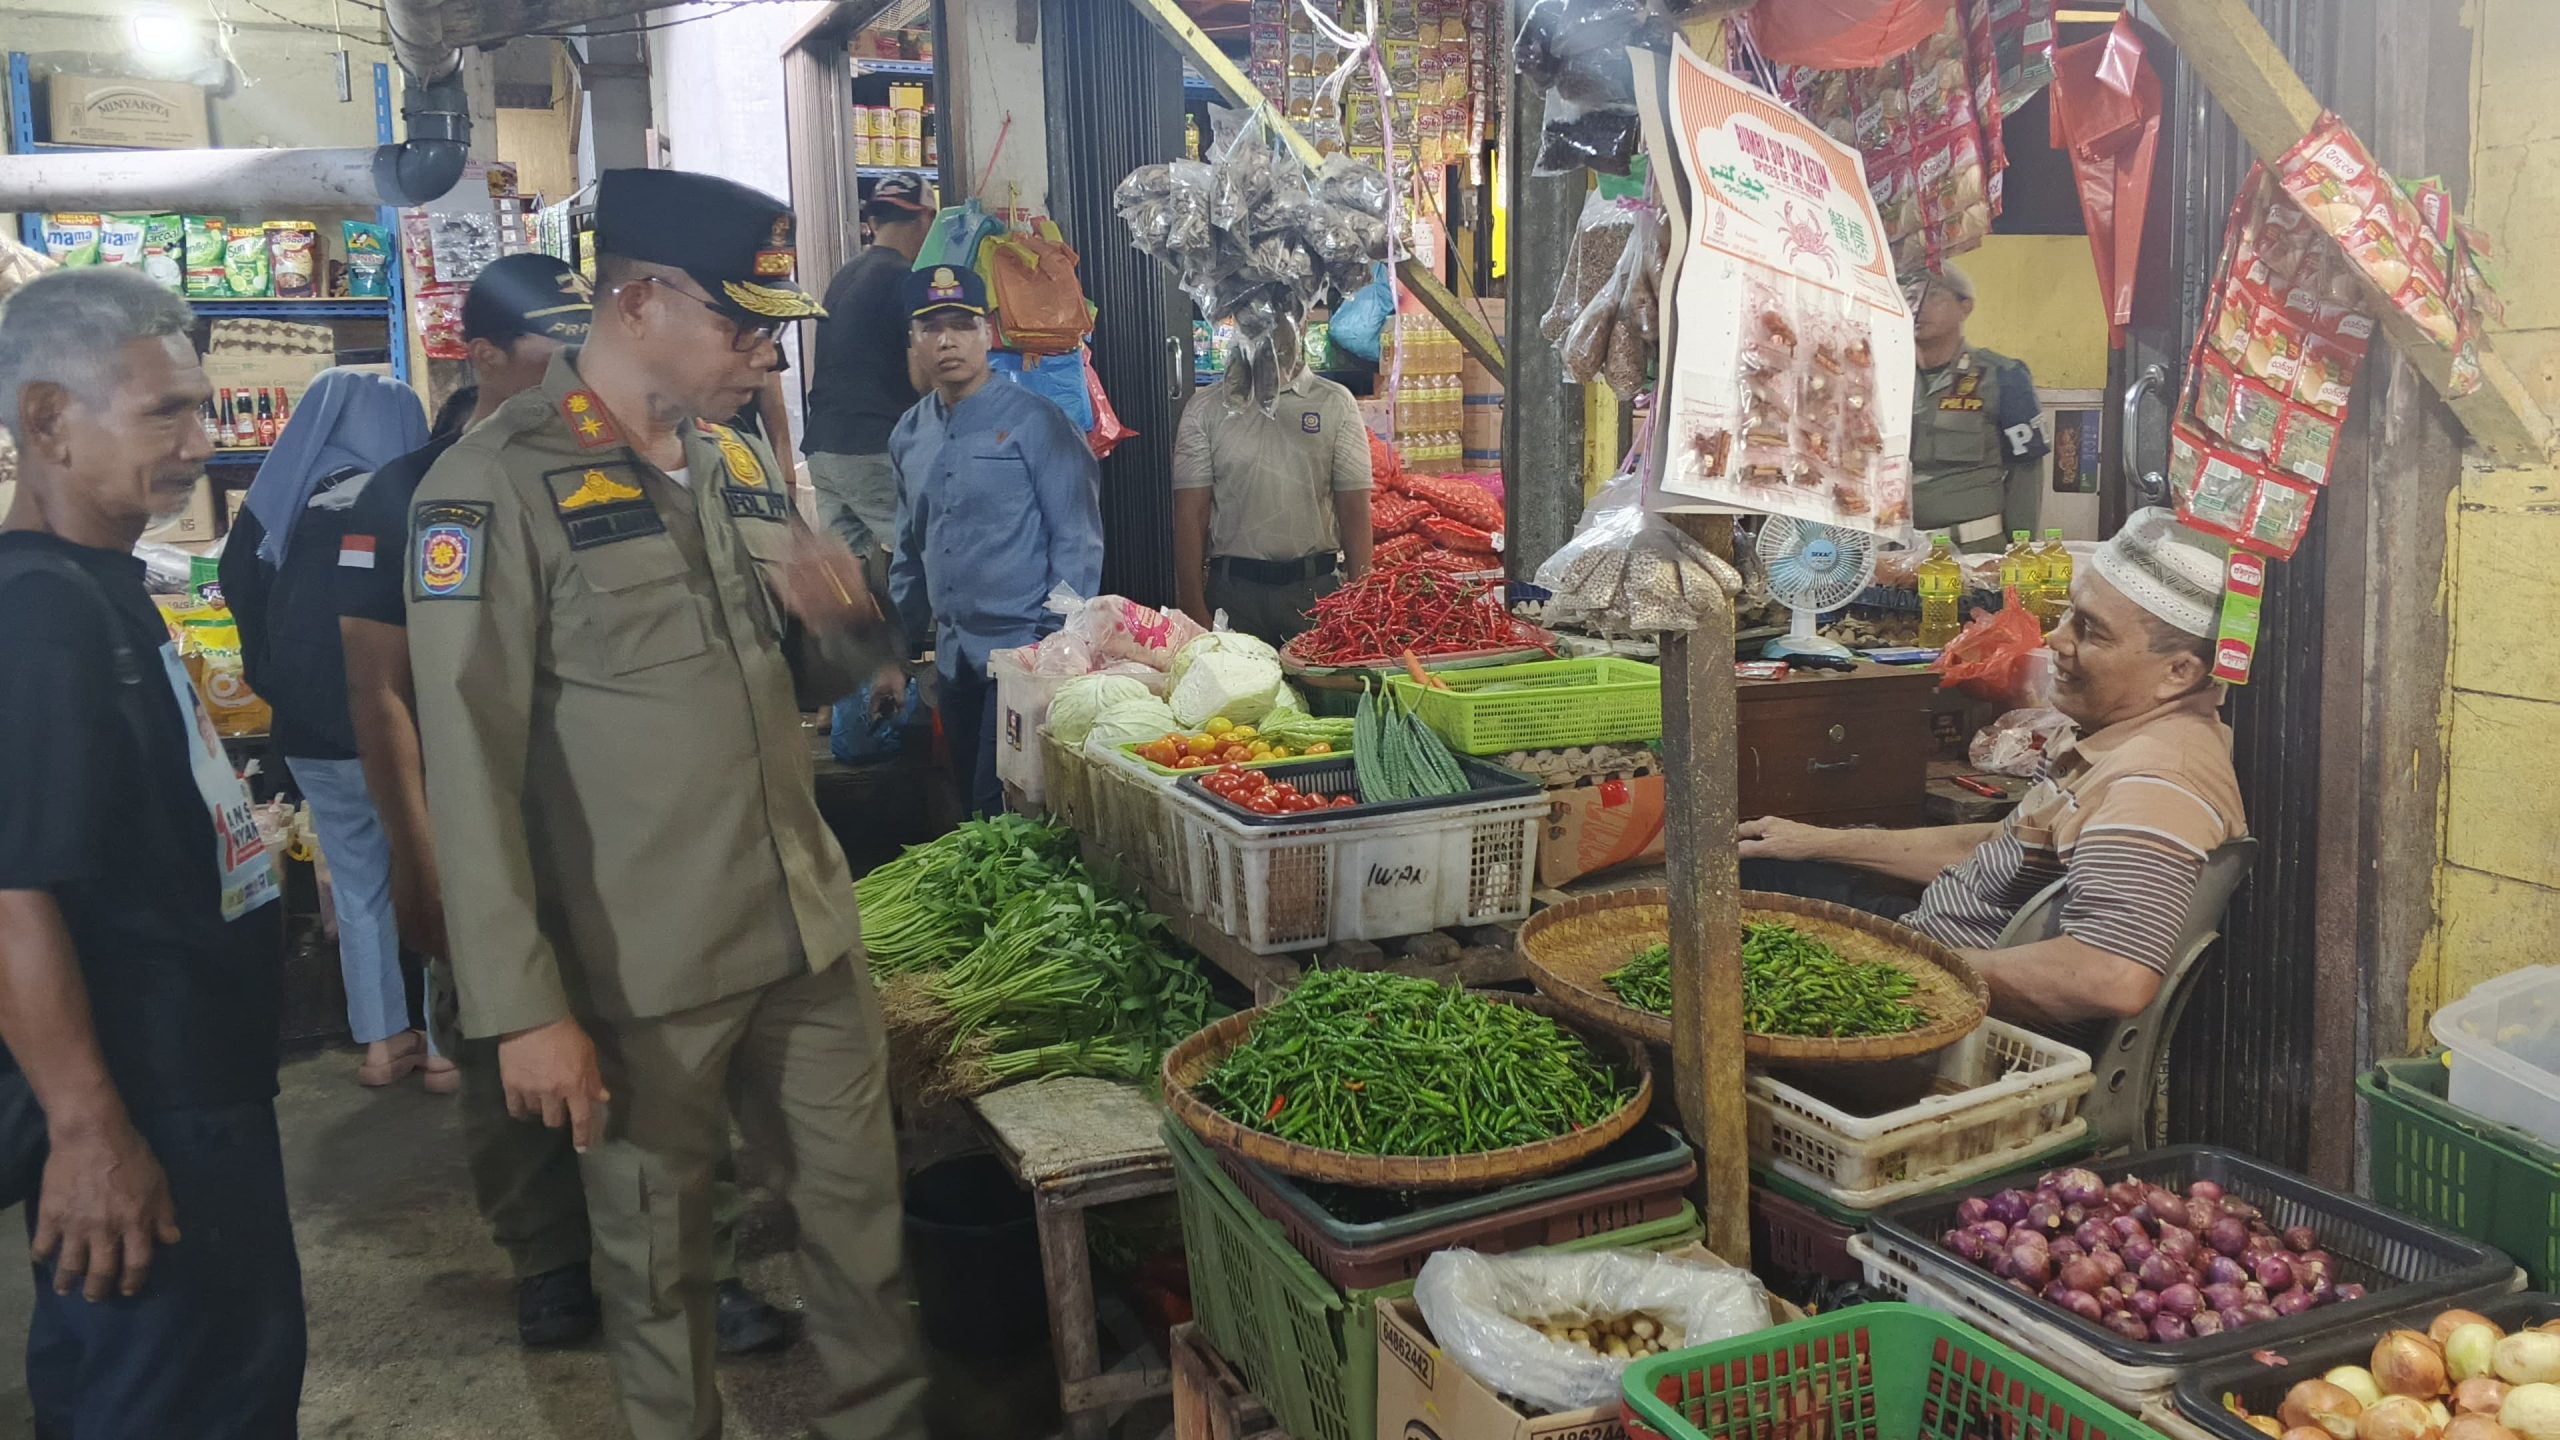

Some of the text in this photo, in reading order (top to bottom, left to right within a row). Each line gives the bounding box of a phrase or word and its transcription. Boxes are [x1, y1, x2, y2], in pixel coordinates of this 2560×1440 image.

[1910, 77, 1937, 99] Royco
[1767, 137, 1786, 169] SUP
[1786, 145, 1803, 177] CAP
[1920, 157, 1948, 179] Royco
[1780, 170, 1790, 184] OF
[1790, 173, 1804, 190] THE
[47, 229, 93, 246] mama
[2184, 261, 2195, 321] ASHO
[2271, 359, 2296, 376] Royco
[2322, 386, 2349, 401] Royco
[2004, 423, 2034, 456] P
[1383, 1321, 1430, 1380] 64862442
